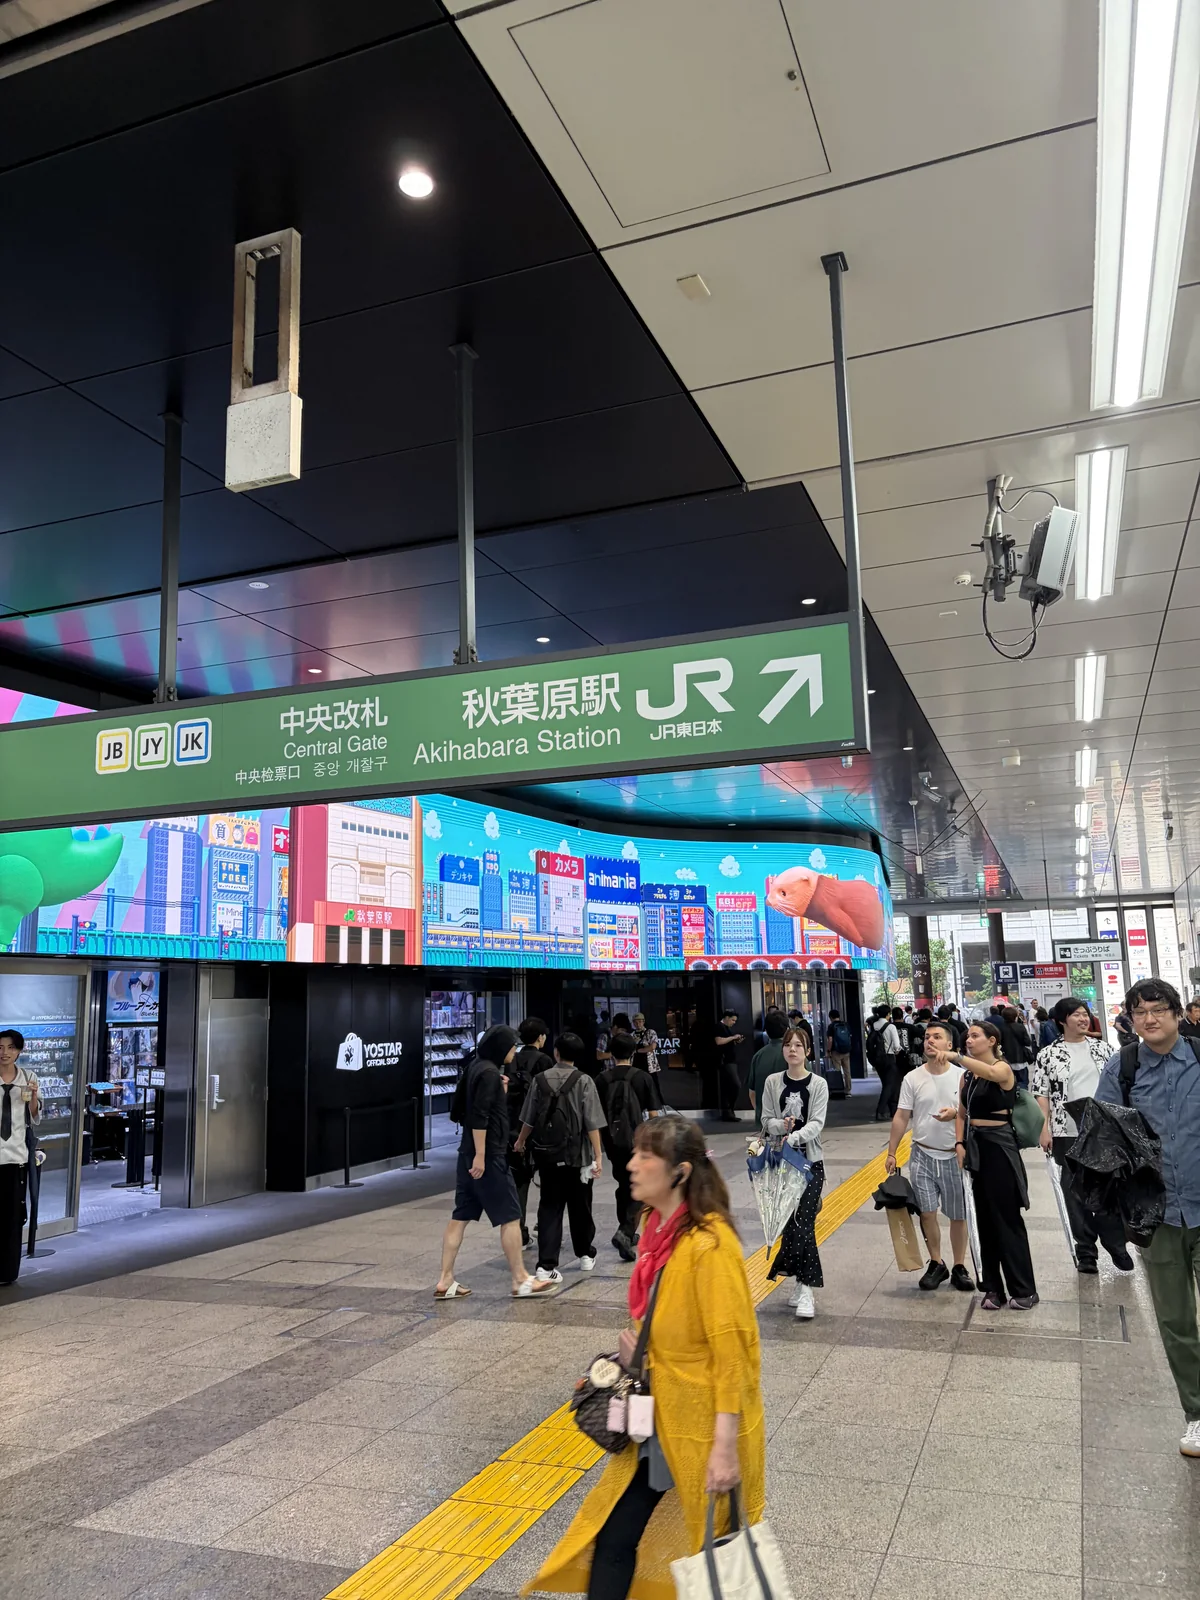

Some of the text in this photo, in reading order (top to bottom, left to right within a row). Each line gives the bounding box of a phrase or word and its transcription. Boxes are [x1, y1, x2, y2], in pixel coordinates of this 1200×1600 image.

[635, 656, 736, 721] JR
[461, 672, 621, 730] 秋葉原駅
[279, 696, 388, 737] 中央改札
[181, 730, 204, 752] JK
[649, 718, 723, 742] JR東日本
[104, 741, 124, 762] JB
[142, 735, 164, 757] JY
[283, 734, 388, 760] Central Gate
[412, 723, 621, 765] Akihabara Station
[234, 764, 301, 786] 中央检票口
[312, 755, 389, 779] 중앙 개찰구
[555, 856, 579, 876] カメラ
[588, 869, 637, 890] animania
[363, 1041, 402, 1059] YOSTAR
[656, 1037, 681, 1048] TAR
[366, 1057, 400, 1068] OFFICIAL SHOP
